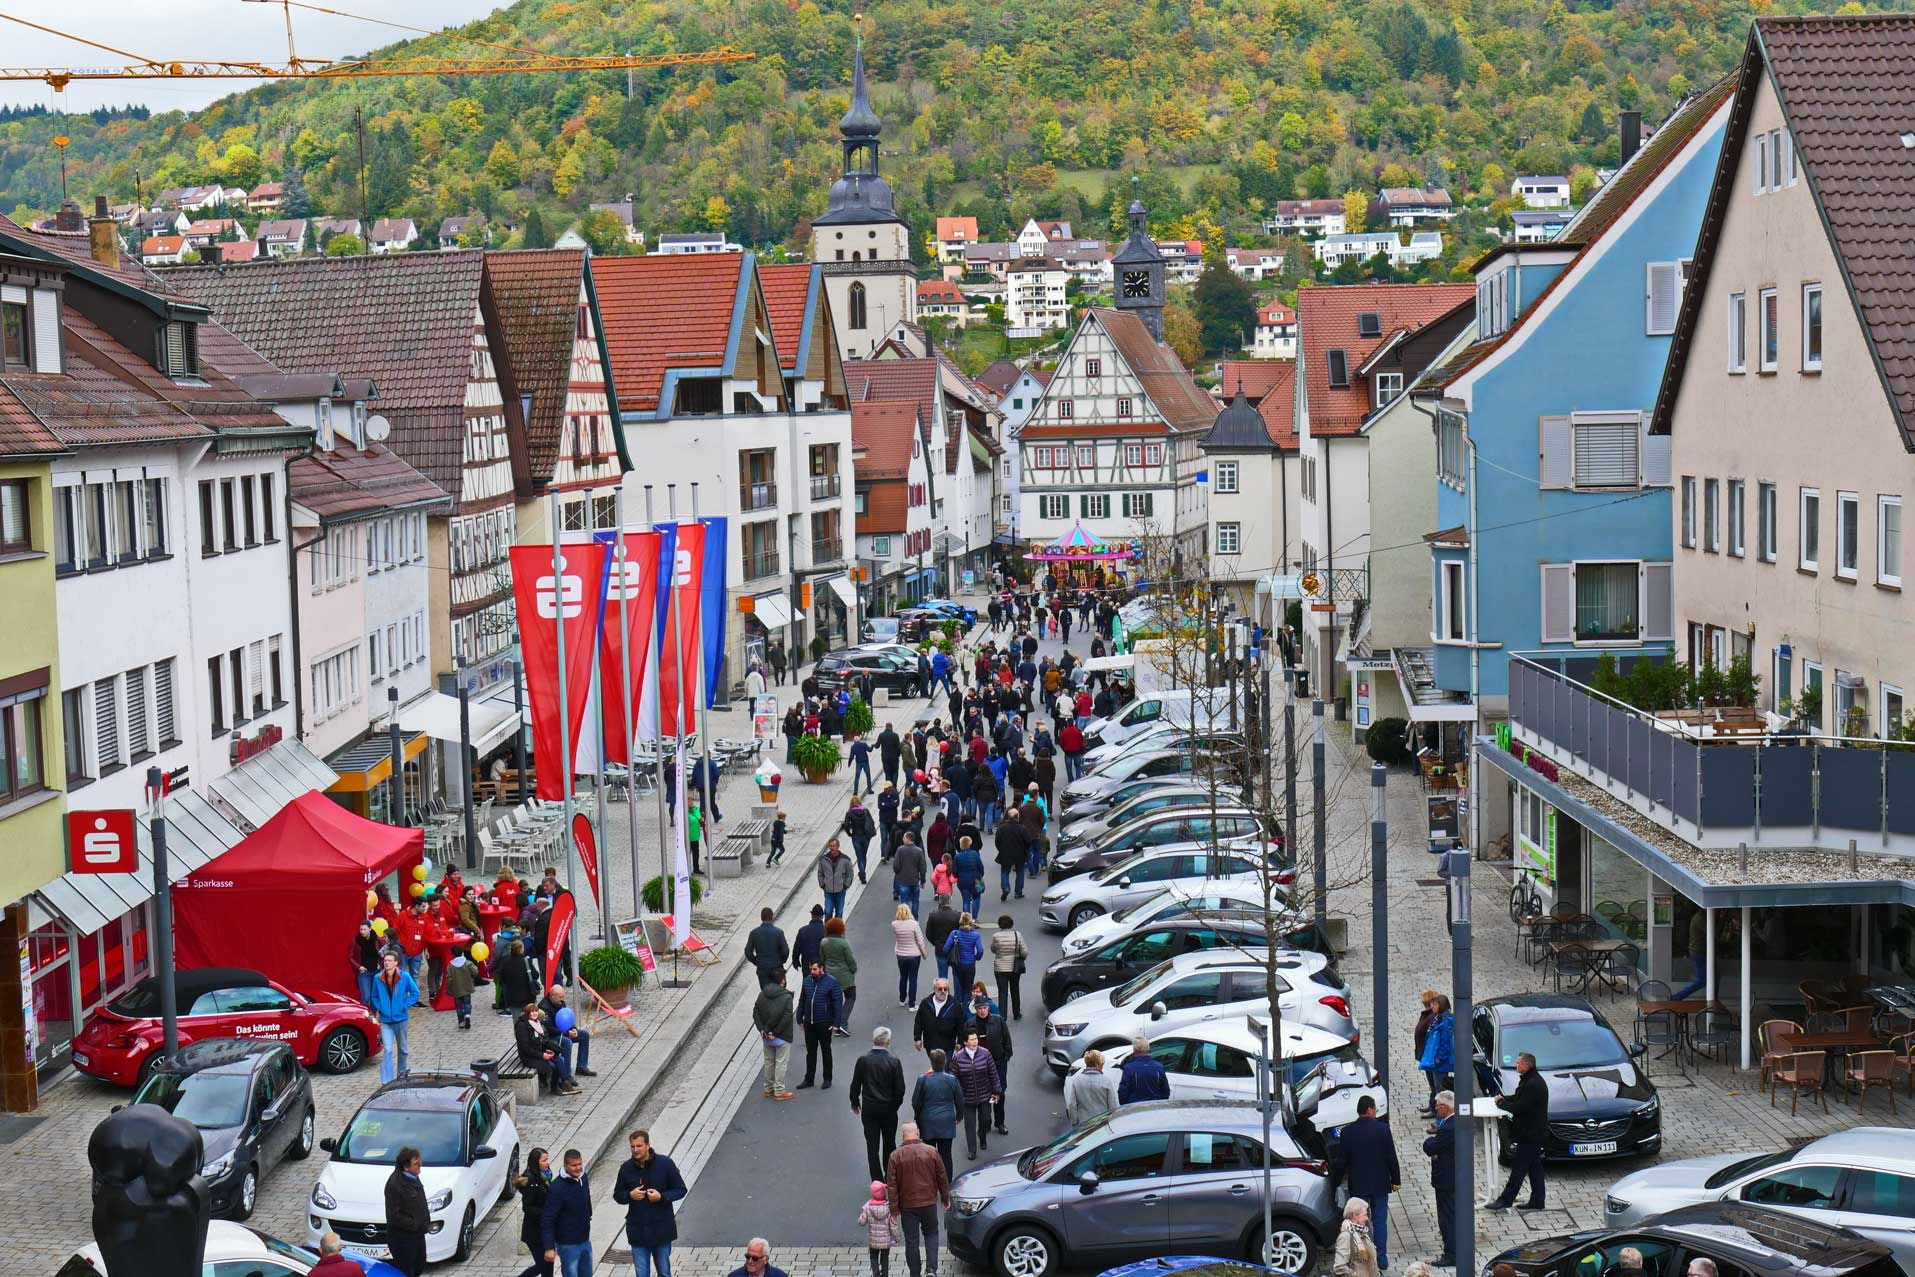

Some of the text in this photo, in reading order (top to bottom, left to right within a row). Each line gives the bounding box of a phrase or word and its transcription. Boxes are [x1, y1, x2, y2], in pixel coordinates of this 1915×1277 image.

[1362, 661, 1393, 669] Metz
[193, 879, 234, 889] Sparkasse
[236, 1023, 280, 1034] Das könnte
[280, 1030, 298, 1040] sein!
